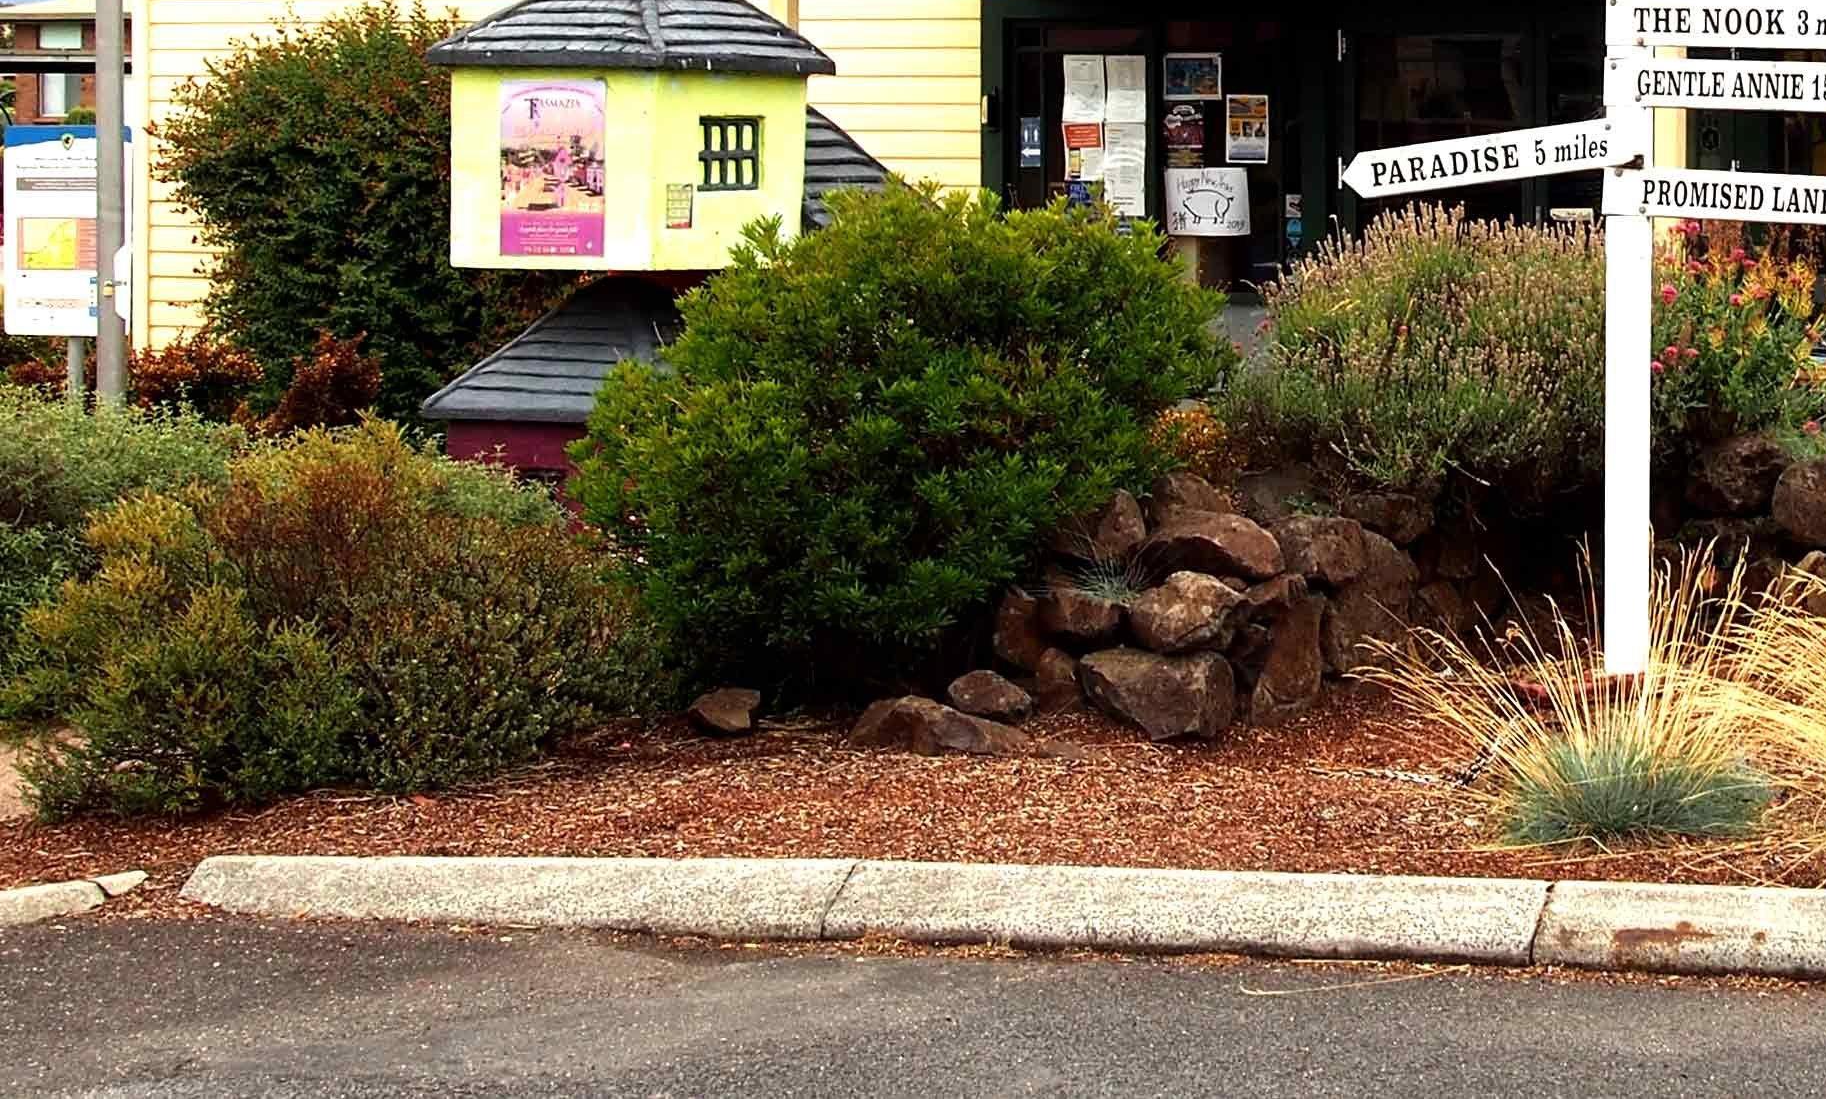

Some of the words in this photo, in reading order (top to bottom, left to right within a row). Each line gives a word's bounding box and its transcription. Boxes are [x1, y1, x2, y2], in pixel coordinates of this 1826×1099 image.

[1633, 7, 1692, 34] THE
[1702, 8, 1786, 36] NOOK
[1797, 9, 1810, 36] 3
[1636, 69, 1725, 98] GENTLE
[1731, 72, 1805, 100] ANNIE
[1371, 144, 1520, 187] PARADISE
[1534, 139, 1547, 166] 5
[1554, 134, 1609, 163] miles
[1641, 179, 1765, 211] PROMISED
